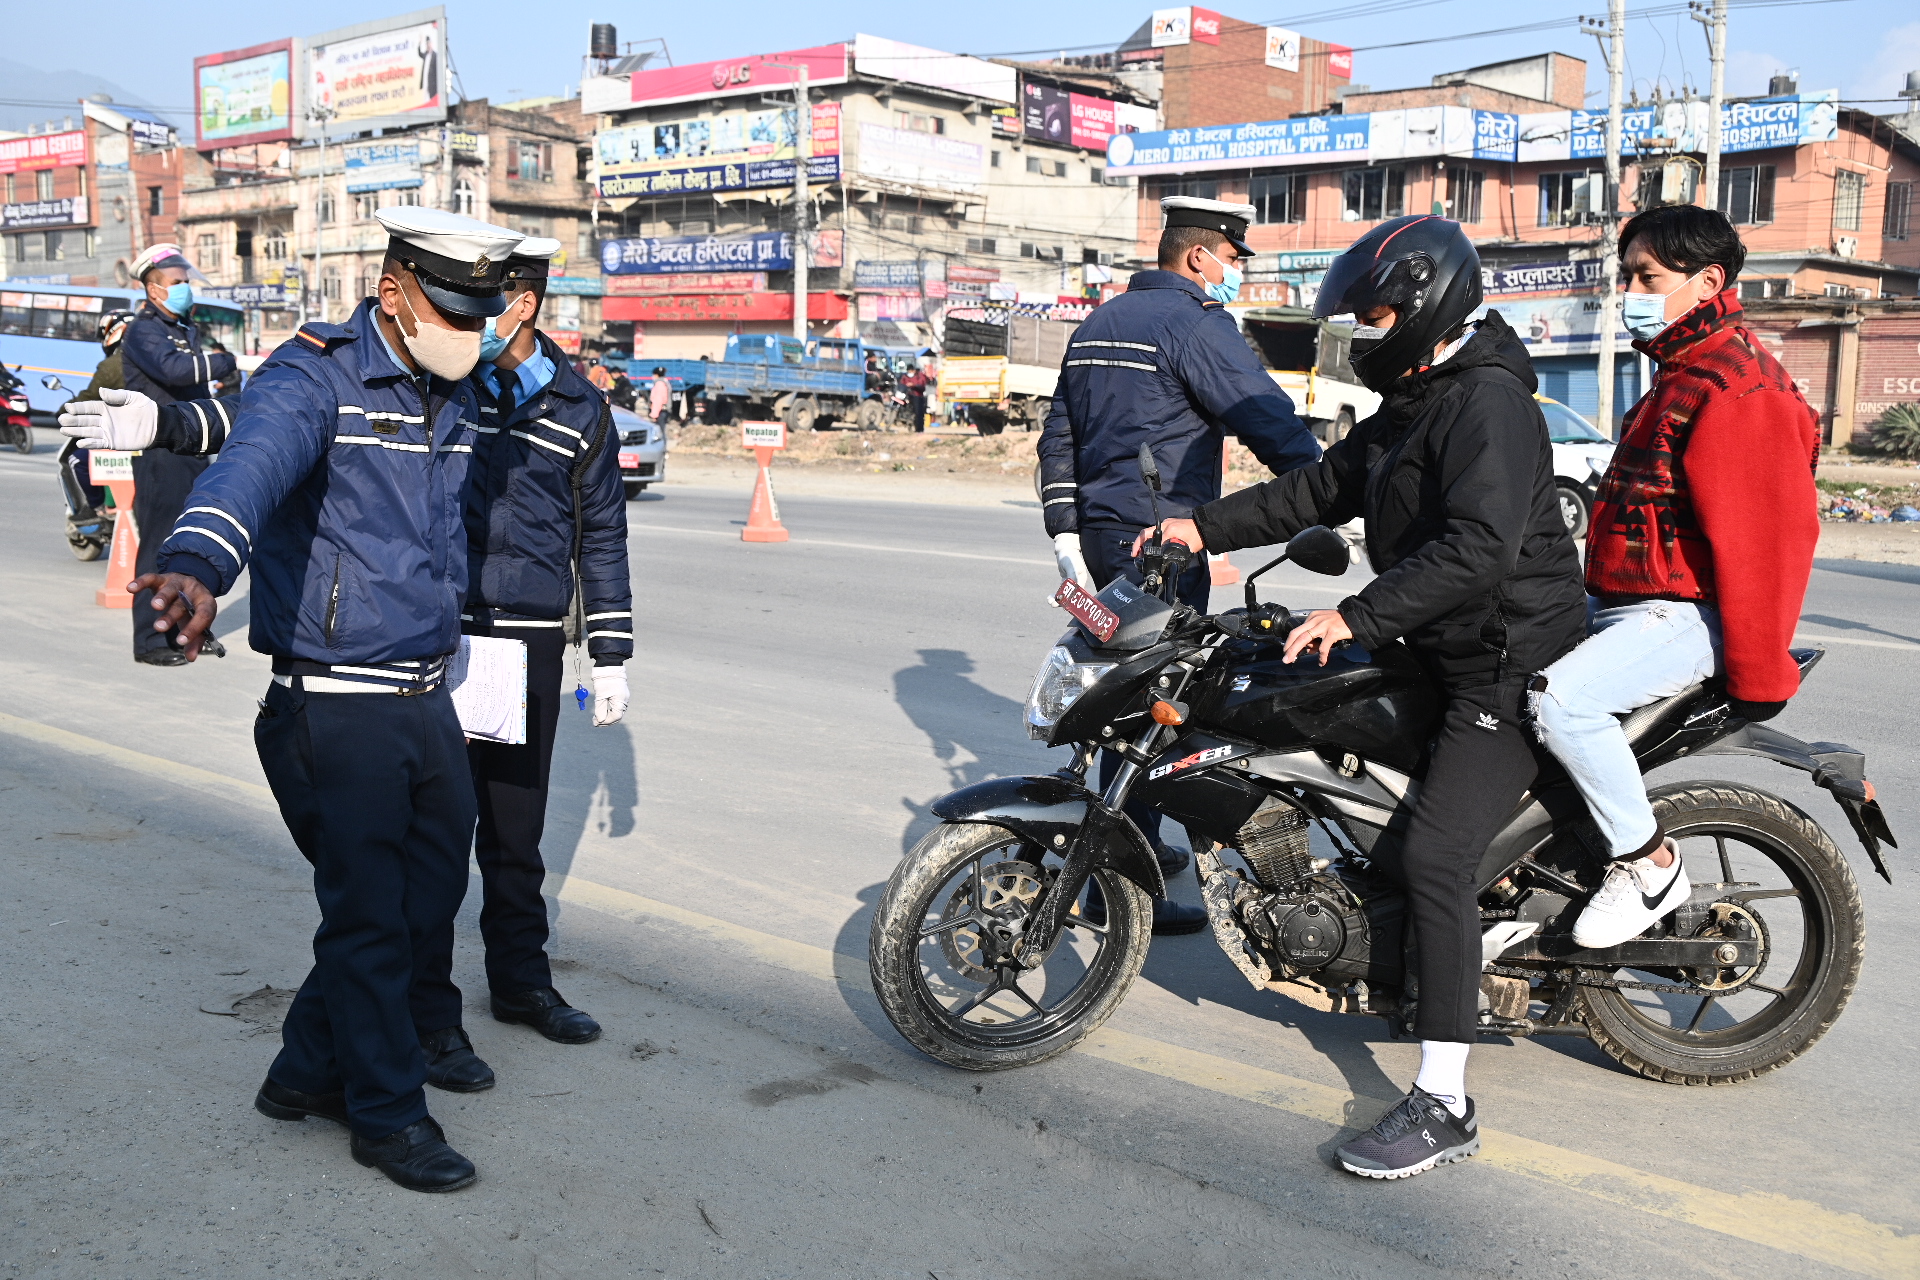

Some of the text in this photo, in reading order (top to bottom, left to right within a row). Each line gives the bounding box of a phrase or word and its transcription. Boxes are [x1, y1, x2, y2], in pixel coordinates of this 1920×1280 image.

[730, 64, 751, 85] LG
[1071, 103, 1115, 124] LG HOUSE
[1478, 111, 1518, 139] मेरो
[1720, 120, 1798, 145] HOSPITAL
[30, 137, 48, 157] JOB
[48, 132, 85, 155] CENTER
[863, 124, 979, 159] MERO DENTAL HOSPITAL
[1168, 128, 1191, 146] मेरो
[1195, 126, 1232, 144] डेन्टल
[1478, 135, 1515, 154] MERO
[1133, 132, 1369, 165] MERO DENTAL HOSPITAL PVT. LTD.
[651, 170, 682, 192] तालिम
[623, 239, 649, 264] मेरो
[650, 238, 694, 263] डेन्टल
[1502, 261, 1577, 288] सप्लायर्स
[1249, 286, 1283, 303] Ltd.
[745, 427, 778, 436] Nepatop
[1112, 588, 1133, 604] SUZUKI
[1290, 949, 1330, 958] SUZUKI
